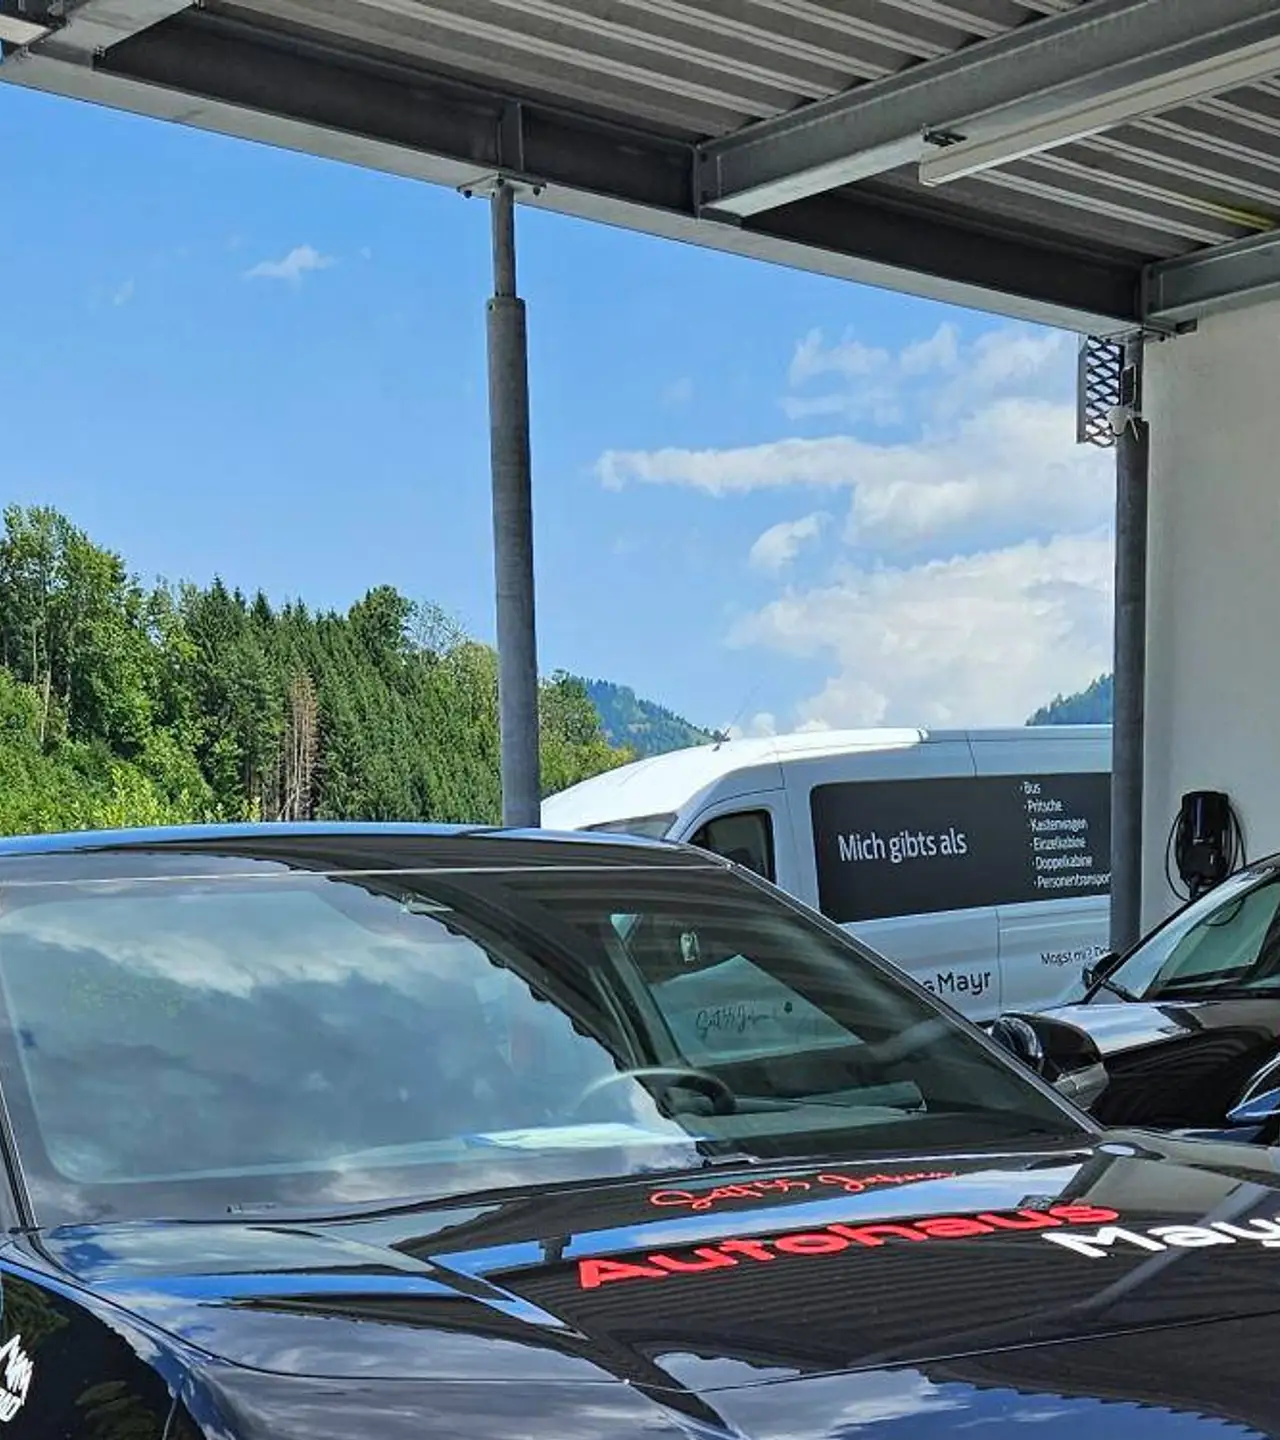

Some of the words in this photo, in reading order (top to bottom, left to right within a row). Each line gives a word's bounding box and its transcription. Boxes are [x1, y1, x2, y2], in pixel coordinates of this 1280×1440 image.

[1024, 781, 1041, 795] Bus
[1027, 800, 1063, 813] Pritsche
[1031, 818, 1088, 833] Kastenwagen
[838, 832, 886, 862] Mich
[889, 830, 938, 864] gibts
[941, 828, 968, 855] als
[1033, 836, 1087, 851] Einzelkabine
[1035, 855, 1093, 872] Doppelkabine
[937, 971, 992, 996] Mayr
[578, 1203, 1120, 1290] Autohaus
